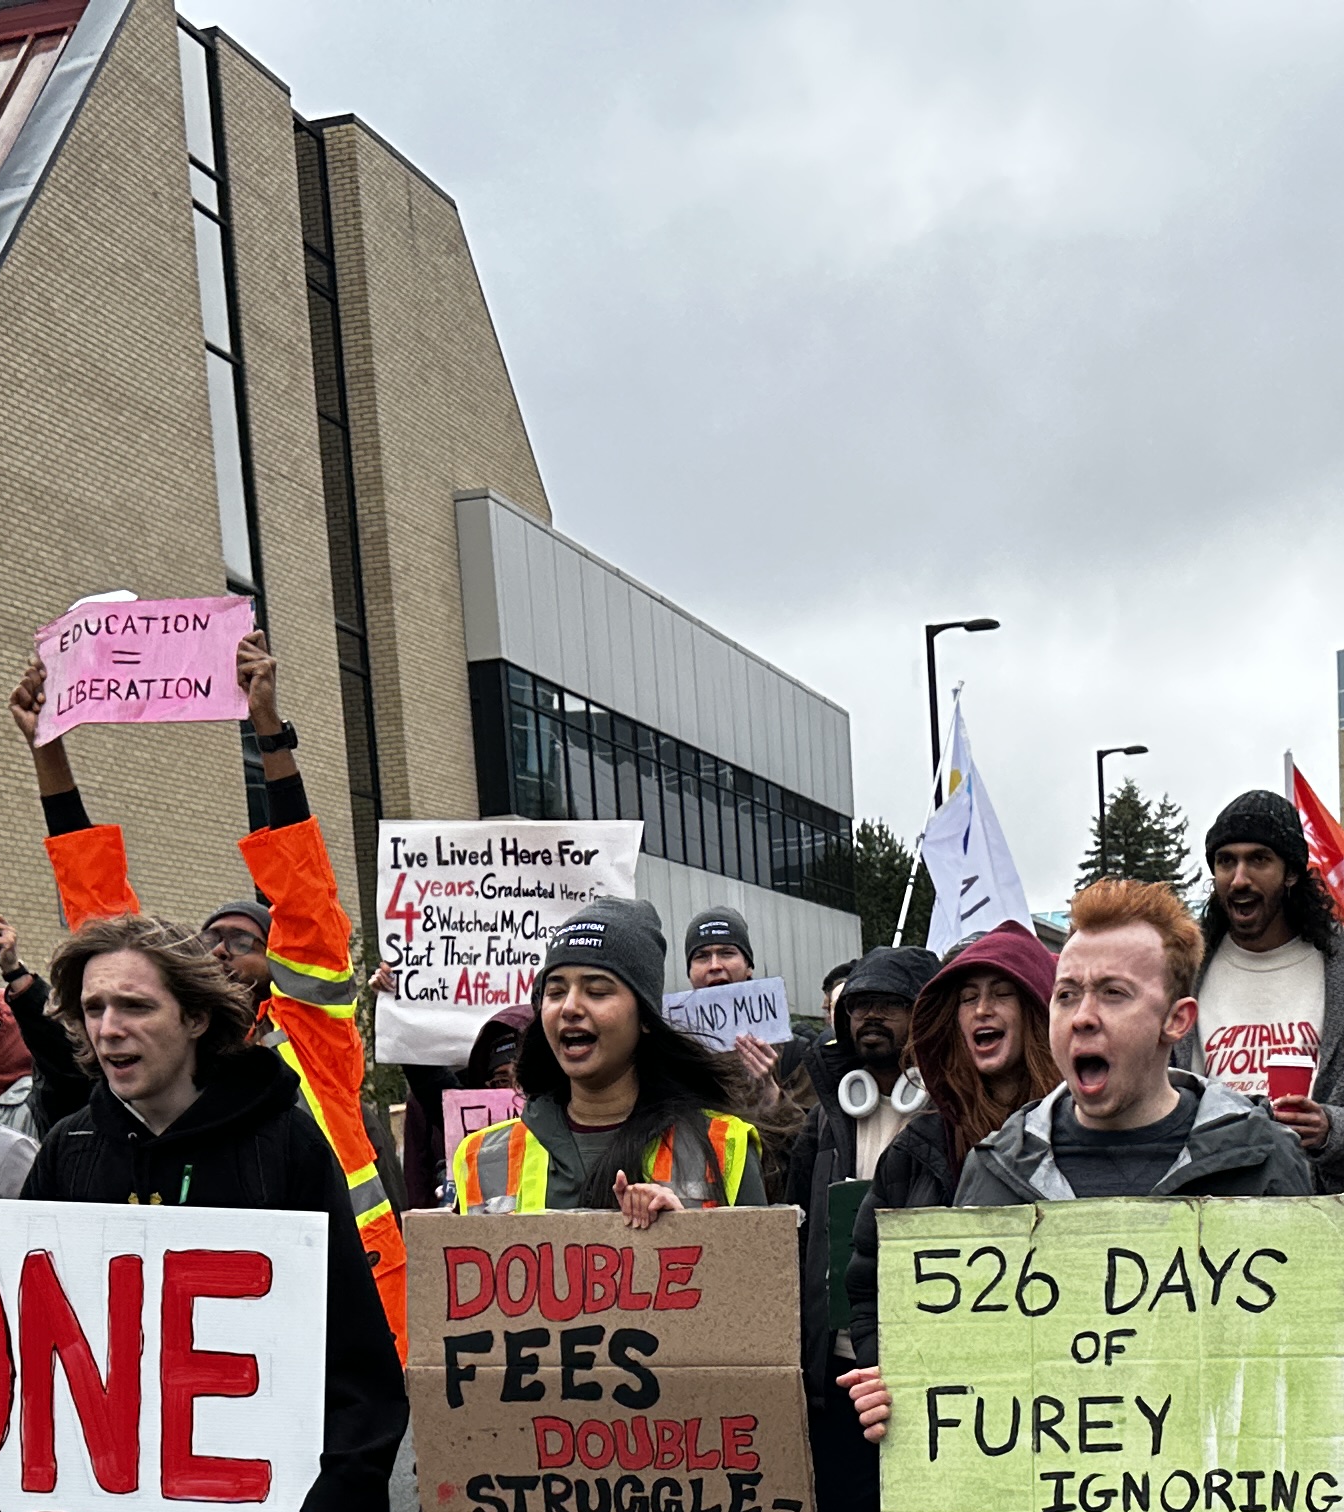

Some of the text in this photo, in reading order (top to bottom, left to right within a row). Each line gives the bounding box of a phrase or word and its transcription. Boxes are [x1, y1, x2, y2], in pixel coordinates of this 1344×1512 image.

[59, 613, 211, 652] EDUCATION
[57, 675, 212, 716] LIBERATION
[390, 835, 599, 869] I've Lived Here For
[384, 872, 422, 943] 4
[480, 872, 555, 900] Graduated
[559, 882, 586, 903] Here
[436, 907, 498, 933] Watched
[500, 910, 521, 942] My
[385, 933, 541, 967] Start Their Future
[392, 969, 403, 1001] I
[404, 969, 449, 1001] Can't
[453, 967, 510, 1006] Afford
[668, 992, 777, 1031] FUND MUN
[1205, 1021, 1321, 1052] CAPITALISM
[443, 1242, 703, 1322] DOUBLE
[913, 1246, 1288, 1317] 526 DAYS
[1071, 1328, 1137, 1366] OF
[443, 1325, 660, 1409] FEES
[532, 1414, 760, 1471] DOUBLE
[926, 1385, 1172, 1462] FUREY
